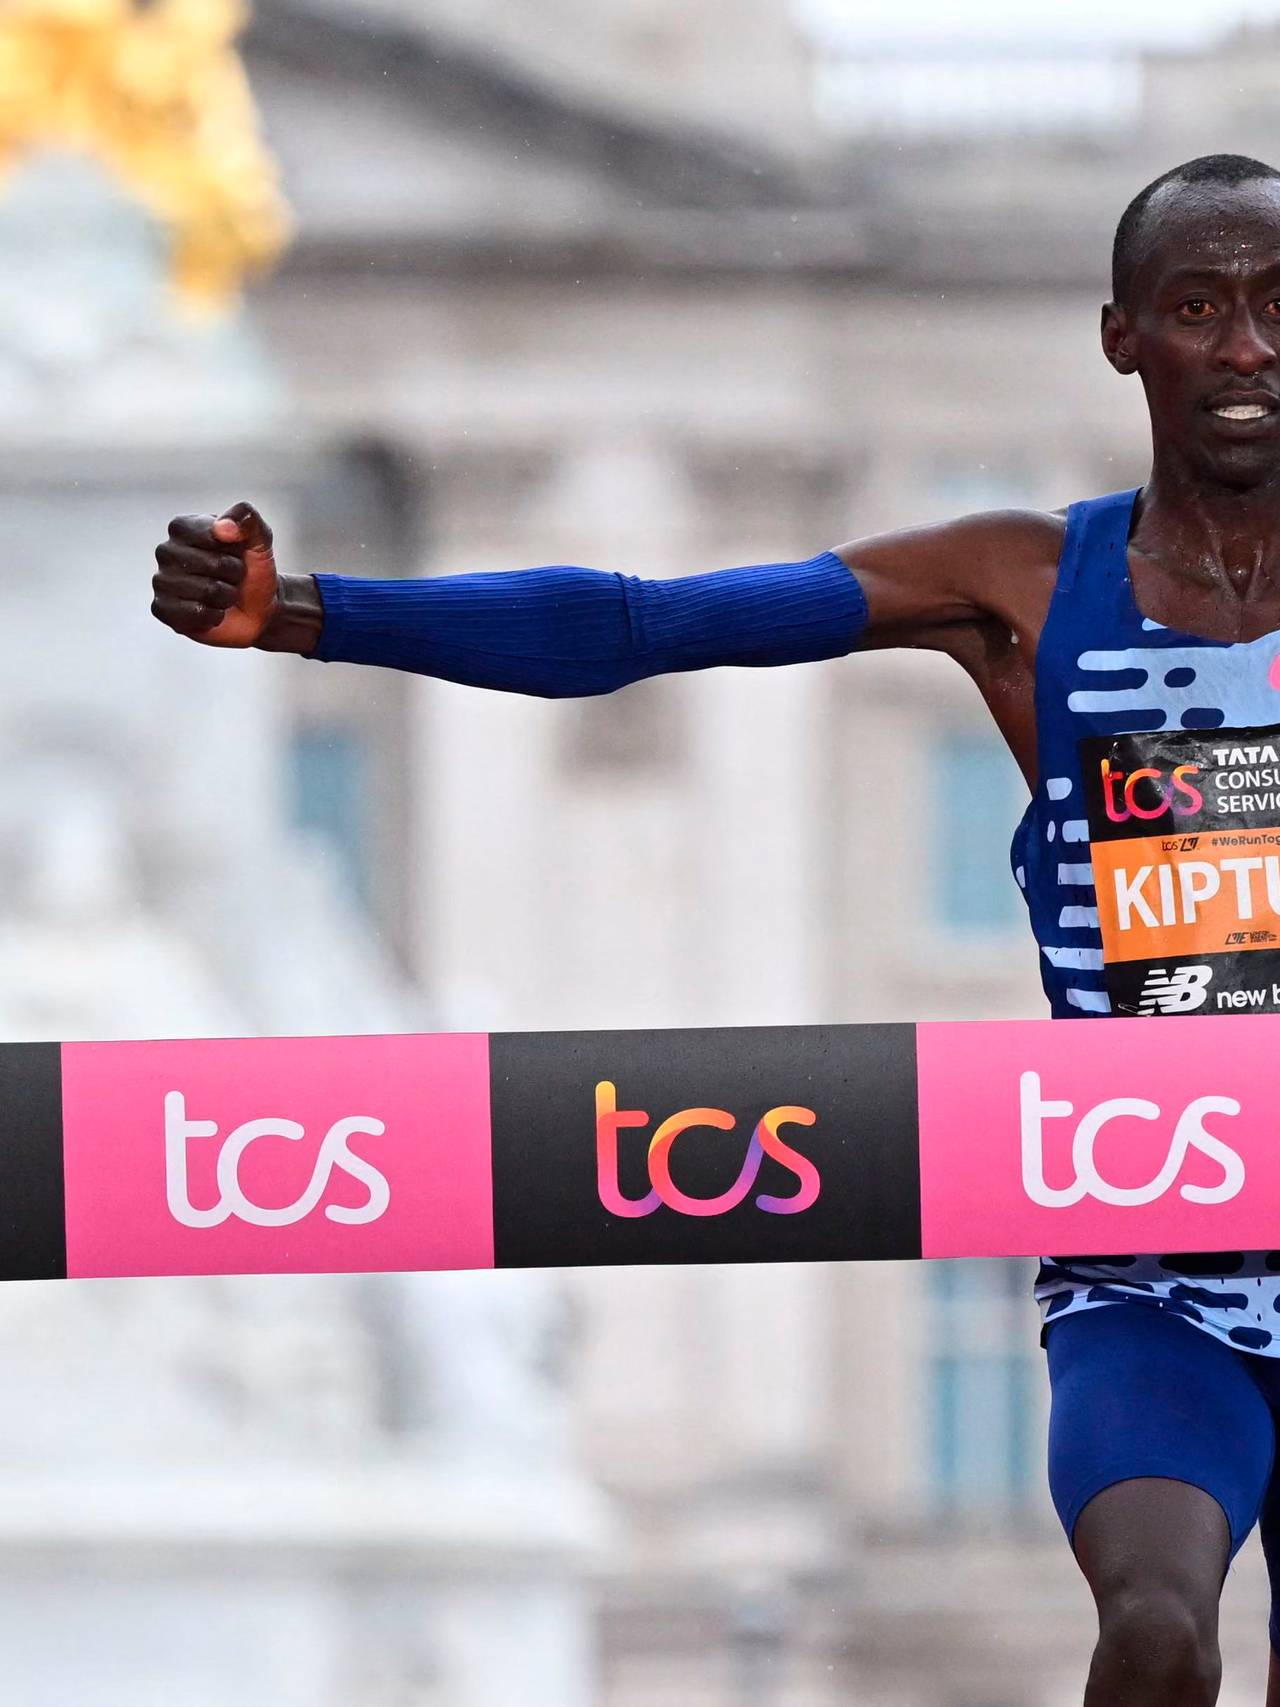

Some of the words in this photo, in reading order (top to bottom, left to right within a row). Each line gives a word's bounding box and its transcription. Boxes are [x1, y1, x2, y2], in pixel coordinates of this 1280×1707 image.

[1101, 759, 1204, 823] tcs
[1213, 745, 1279, 766] TATA
[1217, 989, 1266, 1009] new
[164, 1090, 391, 1229] tcs
[595, 1081, 821, 1218] tcs
[1019, 1070, 1246, 1209] tcs
